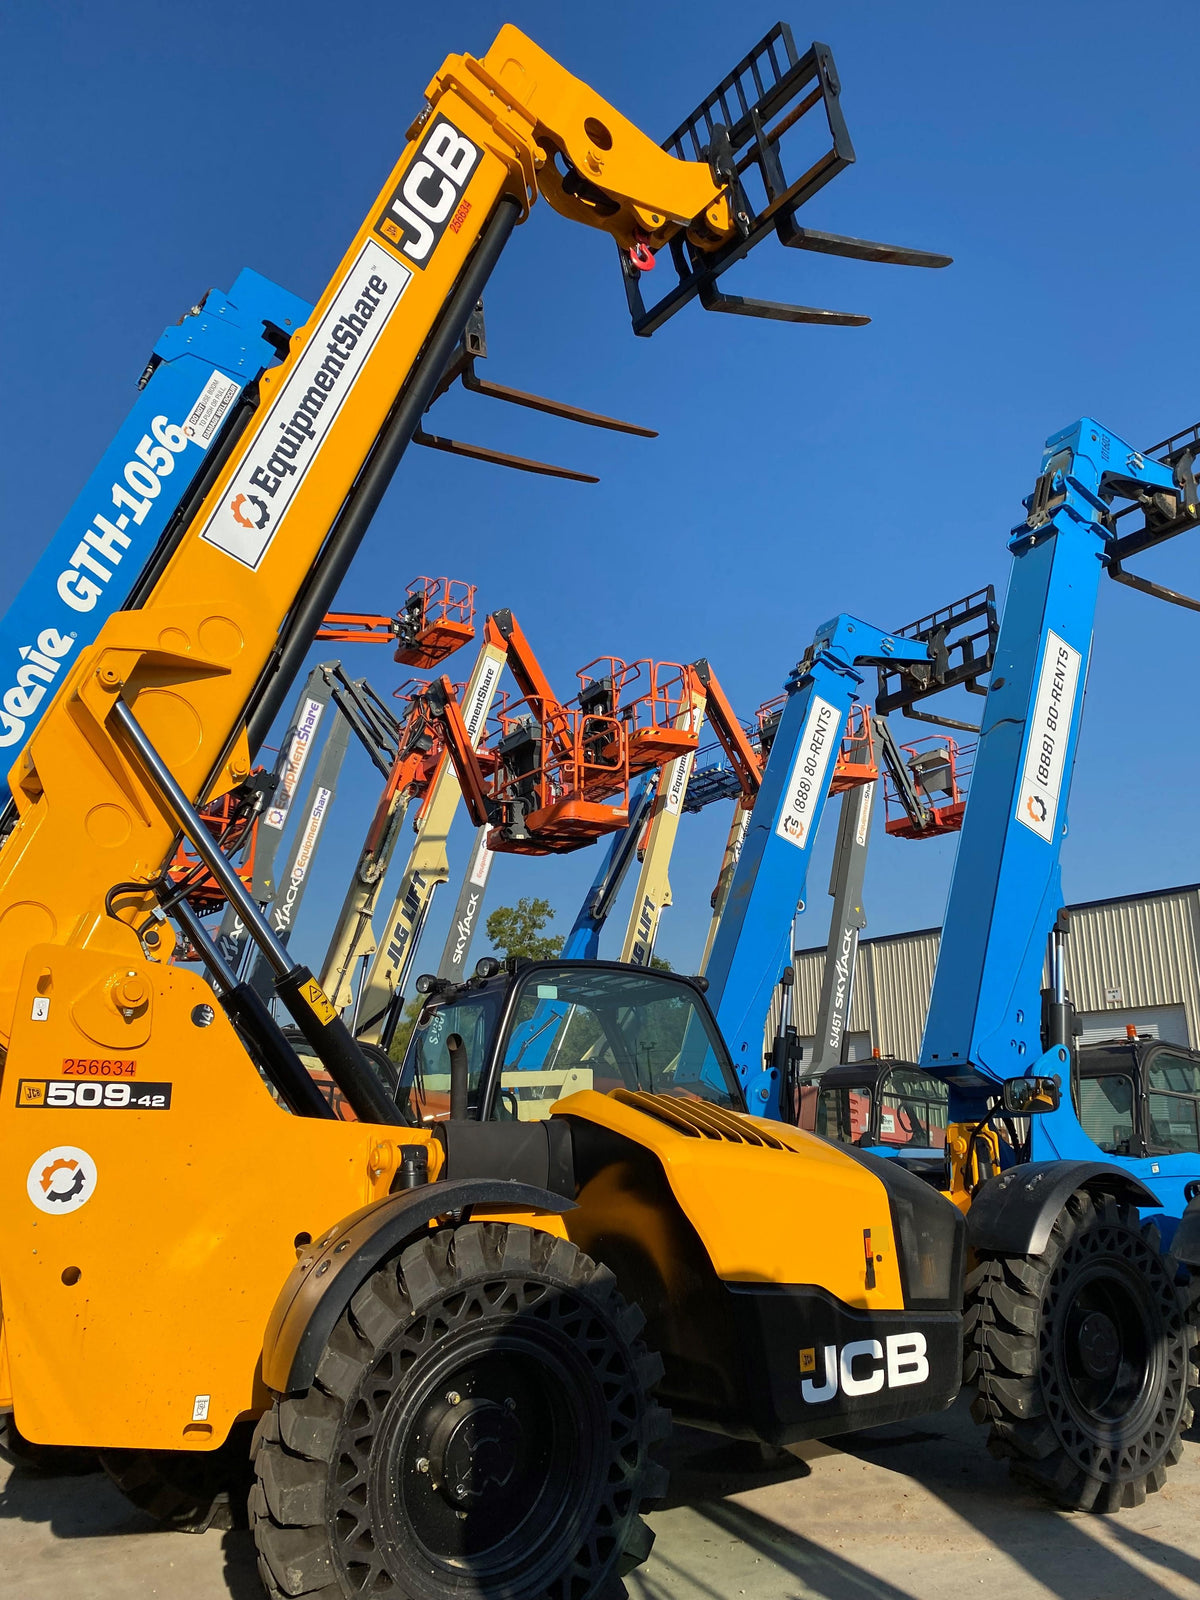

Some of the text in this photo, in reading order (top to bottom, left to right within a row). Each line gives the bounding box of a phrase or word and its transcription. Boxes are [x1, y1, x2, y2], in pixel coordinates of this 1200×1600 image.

[392, 123, 477, 260] JCB
[450, 200, 472, 234] 256634
[190, 379, 219, 425] DO NOT USE BOOM
[202, 384, 238, 440] DAMAGE WILL OCCUR
[205, 406, 215, 420] PUSH
[249, 274, 388, 497] EquipmentShare
[57, 415, 188, 613] GTH-1056
[1036, 647, 1069, 786] (888) 80-RENTS
[274, 702, 320, 810] EquipmentShare
[793, 777, 813, 813] (888)
[804, 707, 832, 777] 80-RENTS
[297, 789, 328, 867] EquipmentShare
[387, 870, 427, 970] JLG LIFT
[452, 893, 479, 964] SKYJACK
[638, 894, 655, 943] LIFT
[830, 927, 853, 1048] SJ45T SKYJACK
[47, 1082, 166, 1107] 509-42
[63, 1059, 136, 1076] 256634
[801, 1332, 930, 1403] JCB
